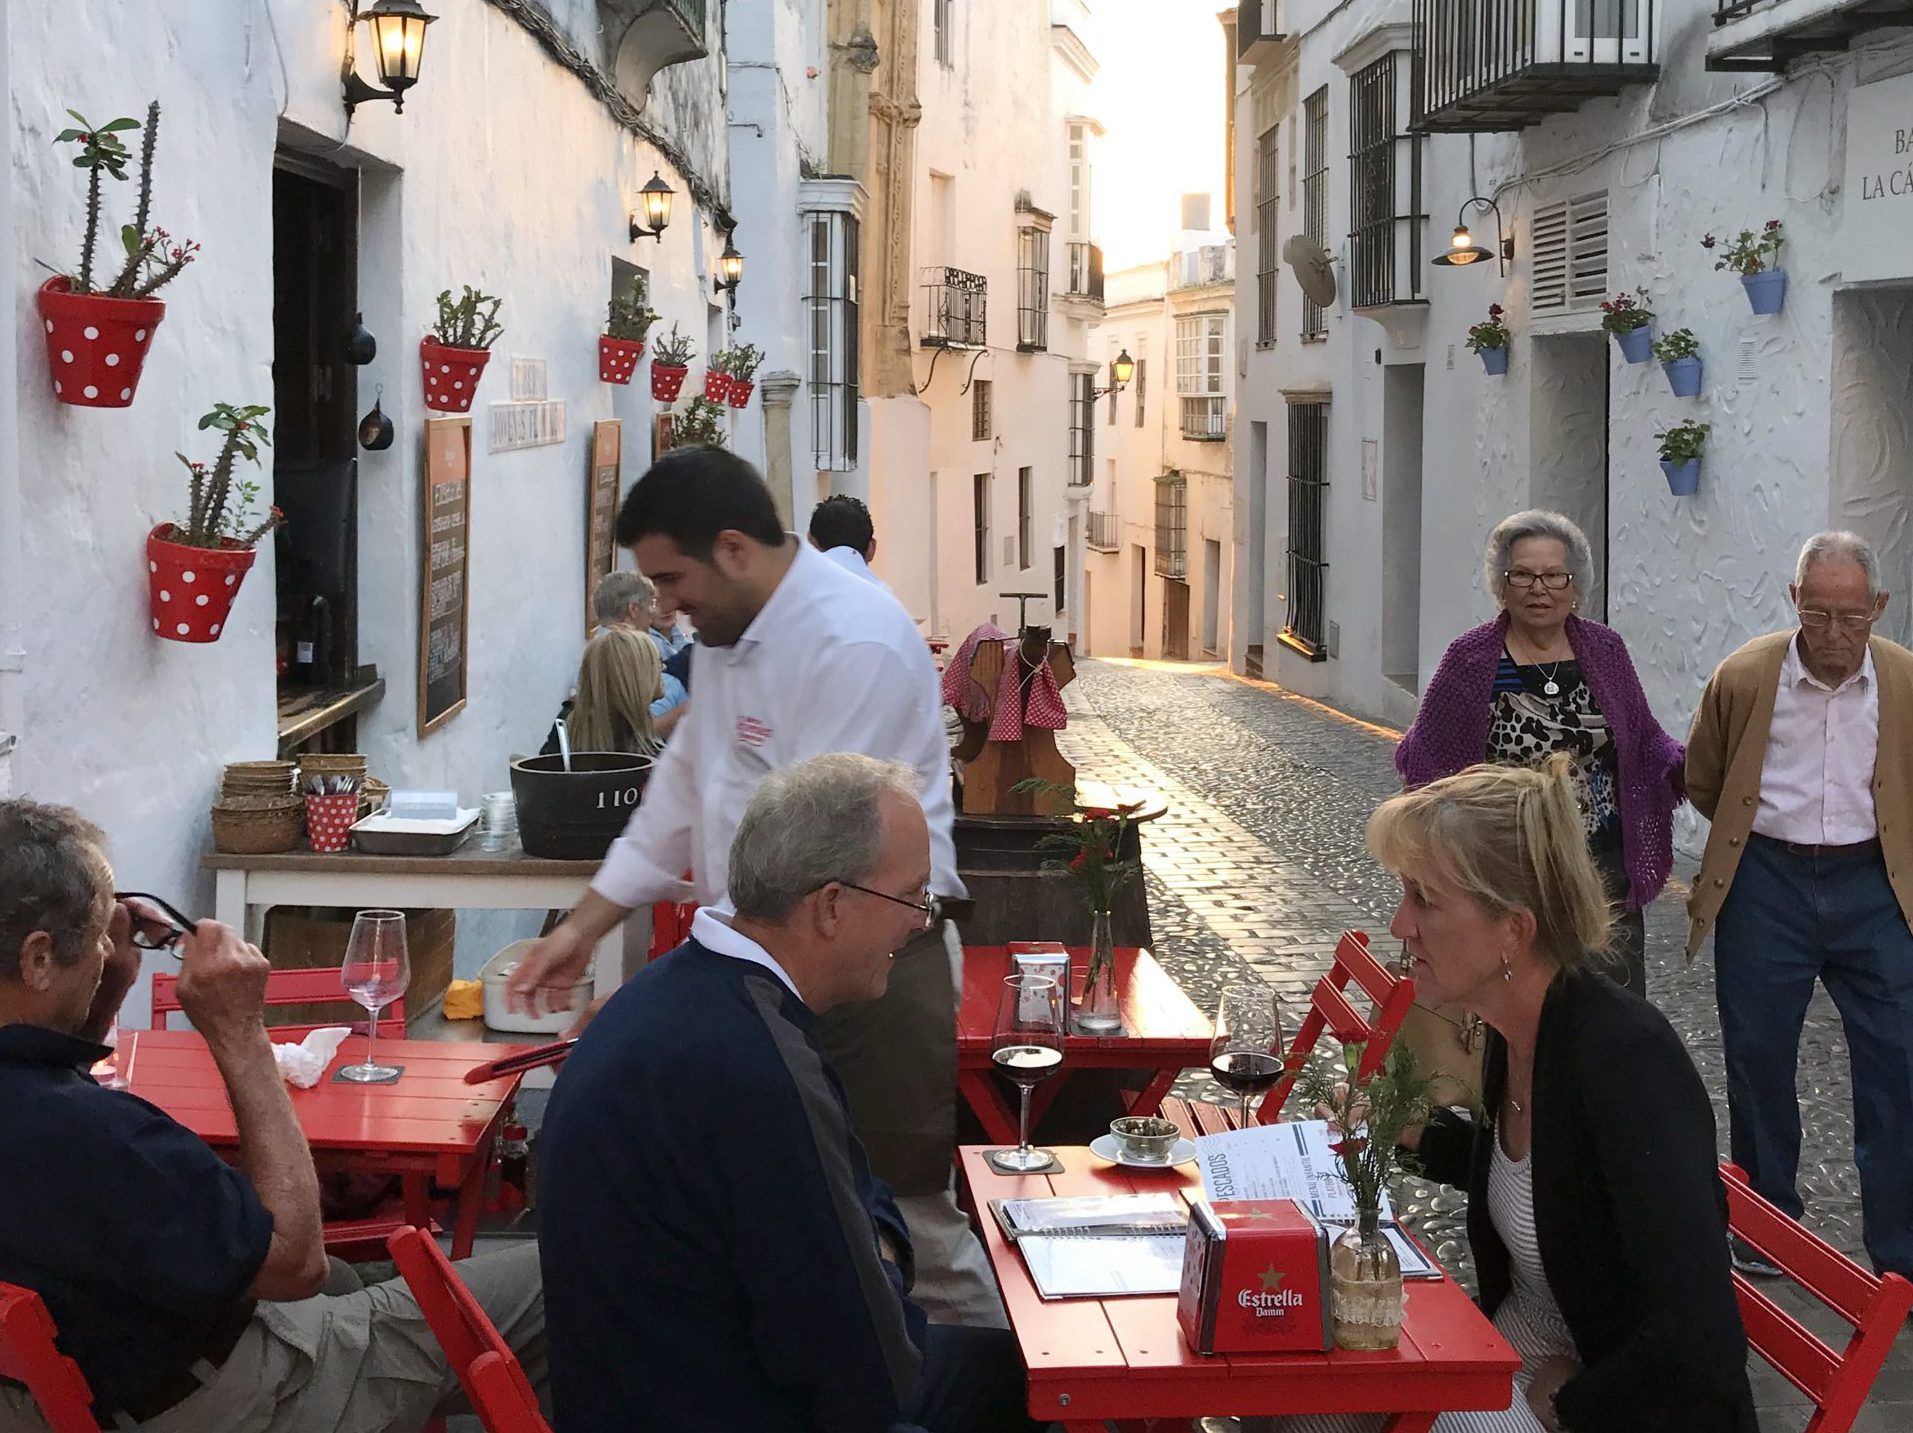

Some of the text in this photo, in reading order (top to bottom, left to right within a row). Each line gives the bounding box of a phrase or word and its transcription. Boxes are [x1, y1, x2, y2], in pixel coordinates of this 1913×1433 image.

[1863, 162, 1913, 201] LA CÁ
[1238, 1288, 1303, 1308] Estrella
[1255, 1307, 1285, 1317] Damm
